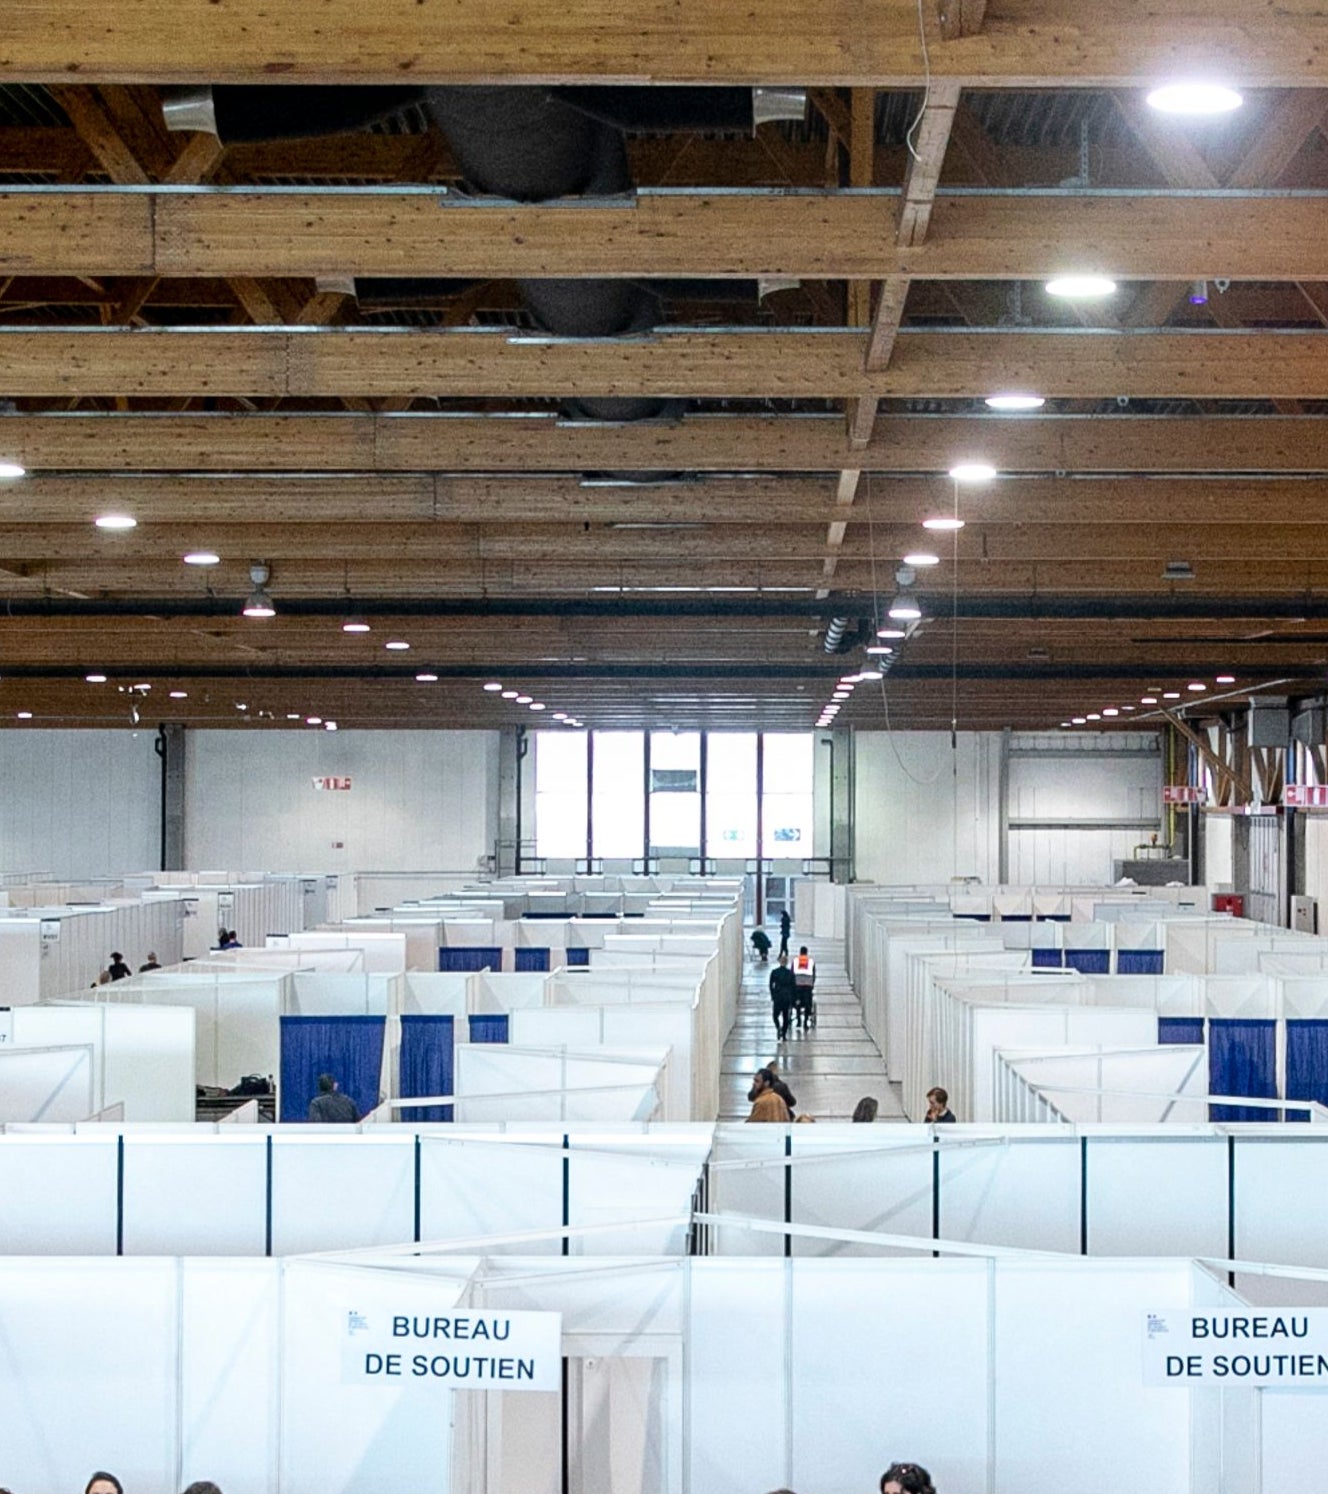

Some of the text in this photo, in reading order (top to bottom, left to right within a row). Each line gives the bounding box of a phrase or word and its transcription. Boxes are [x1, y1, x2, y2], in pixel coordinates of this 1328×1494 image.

[392, 1315, 511, 1341] BUREAU
[1191, 1316, 1309, 1339] BUREAU
[364, 1353, 535, 1380] DE SOUTIEN
[1165, 1355, 1203, 1377] DE
